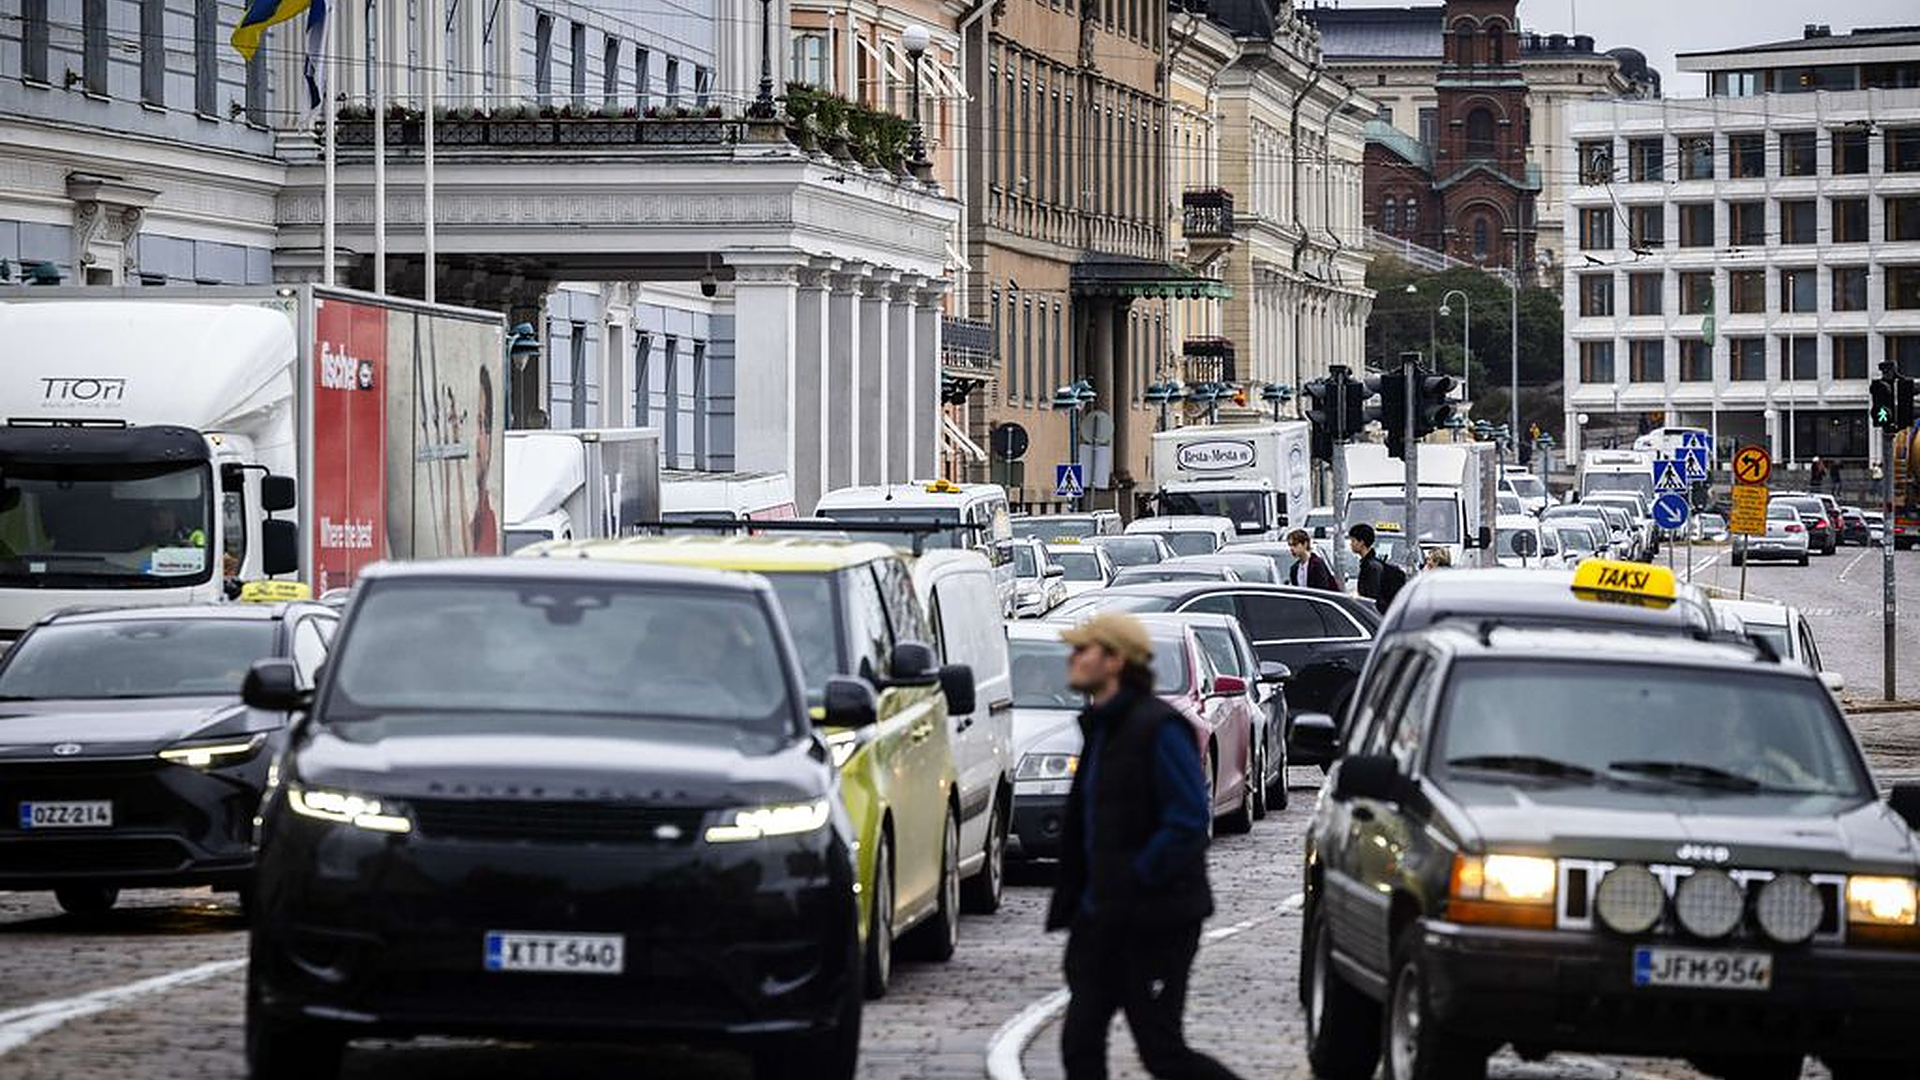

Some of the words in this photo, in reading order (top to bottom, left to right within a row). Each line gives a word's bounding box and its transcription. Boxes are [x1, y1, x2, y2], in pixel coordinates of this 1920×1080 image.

[321, 341, 358, 391] fischer
[40, 377, 126, 400] TiOri
[1184, 448, 1238, 463] Resta-Mesta
[1597, 567, 1651, 589] TAKSI
[34, 806, 108, 824] OZZ-214
[508, 941, 616, 967] XTT-540
[1655, 955, 1764, 984] JFM-954
